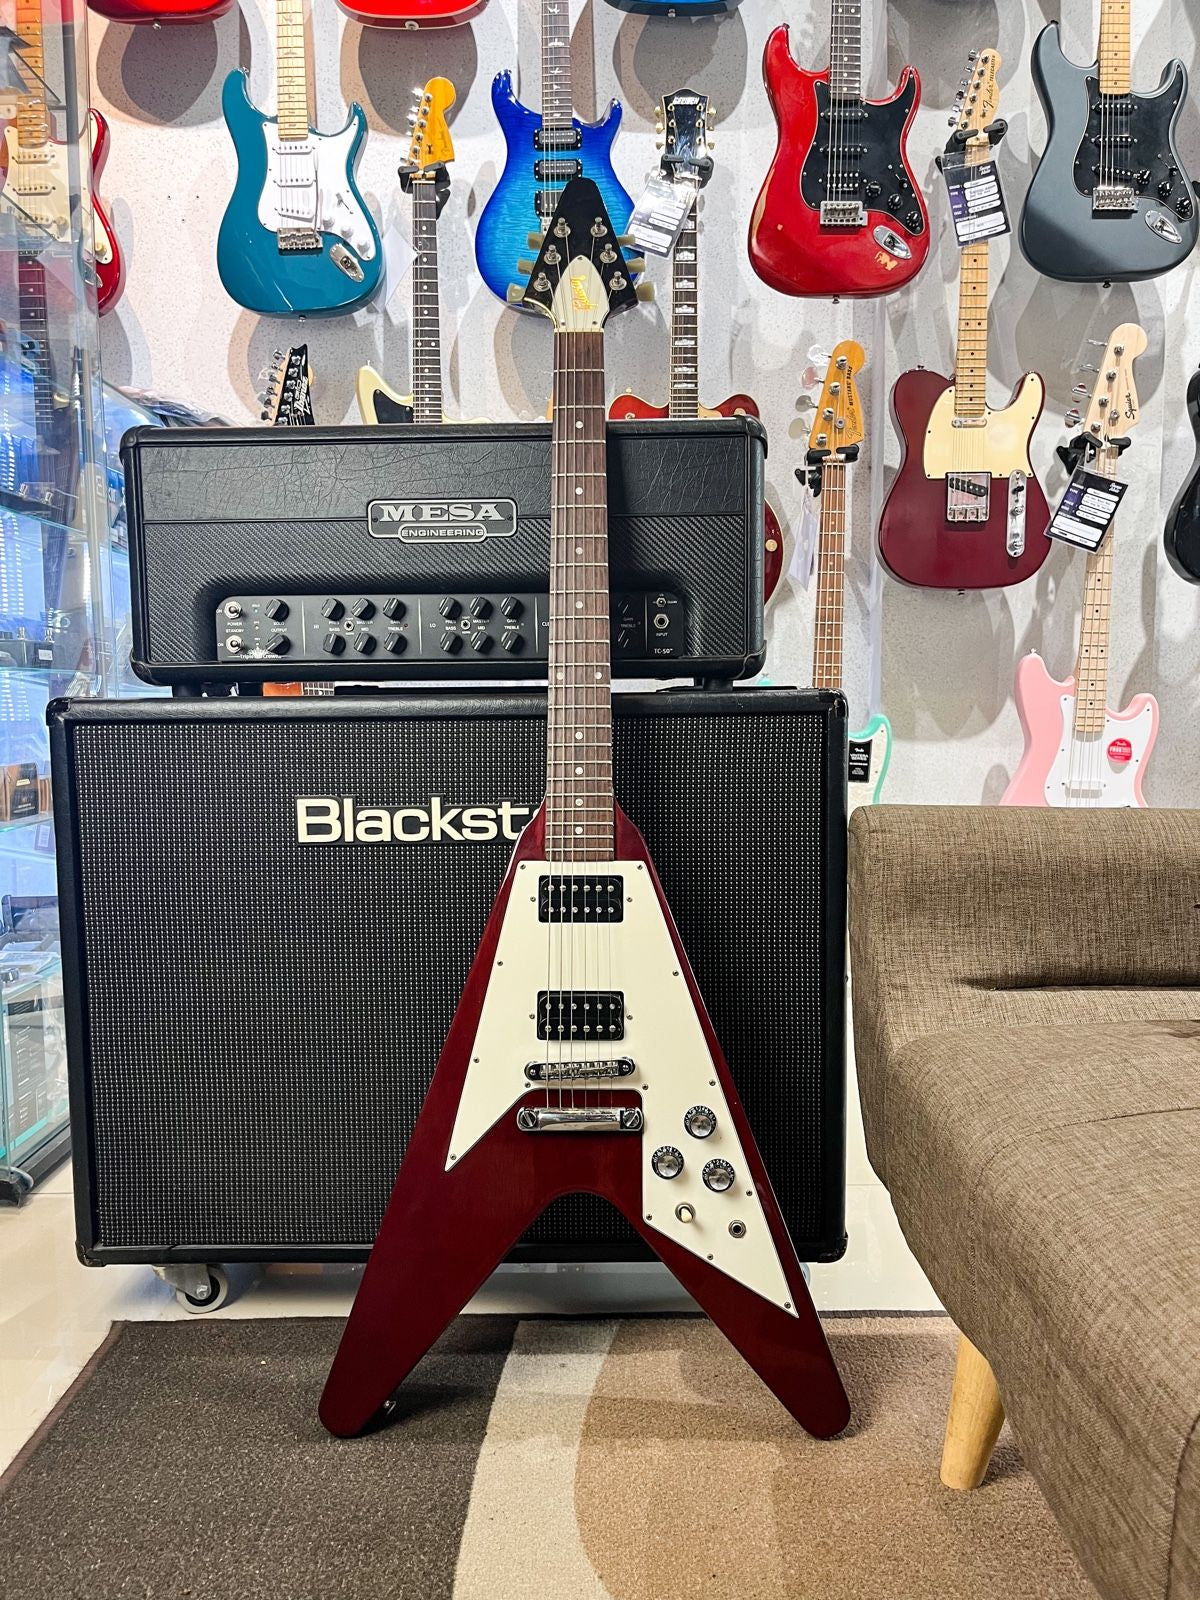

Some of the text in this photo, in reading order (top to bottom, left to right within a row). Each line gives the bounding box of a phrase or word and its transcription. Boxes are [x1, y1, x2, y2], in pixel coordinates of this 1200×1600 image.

[1125, 392, 1137, 420] Squier
[378, 503, 505, 522] MESA
[401, 528, 485, 537] ENGINEERING
[297, 796, 540, 843] Blackst
